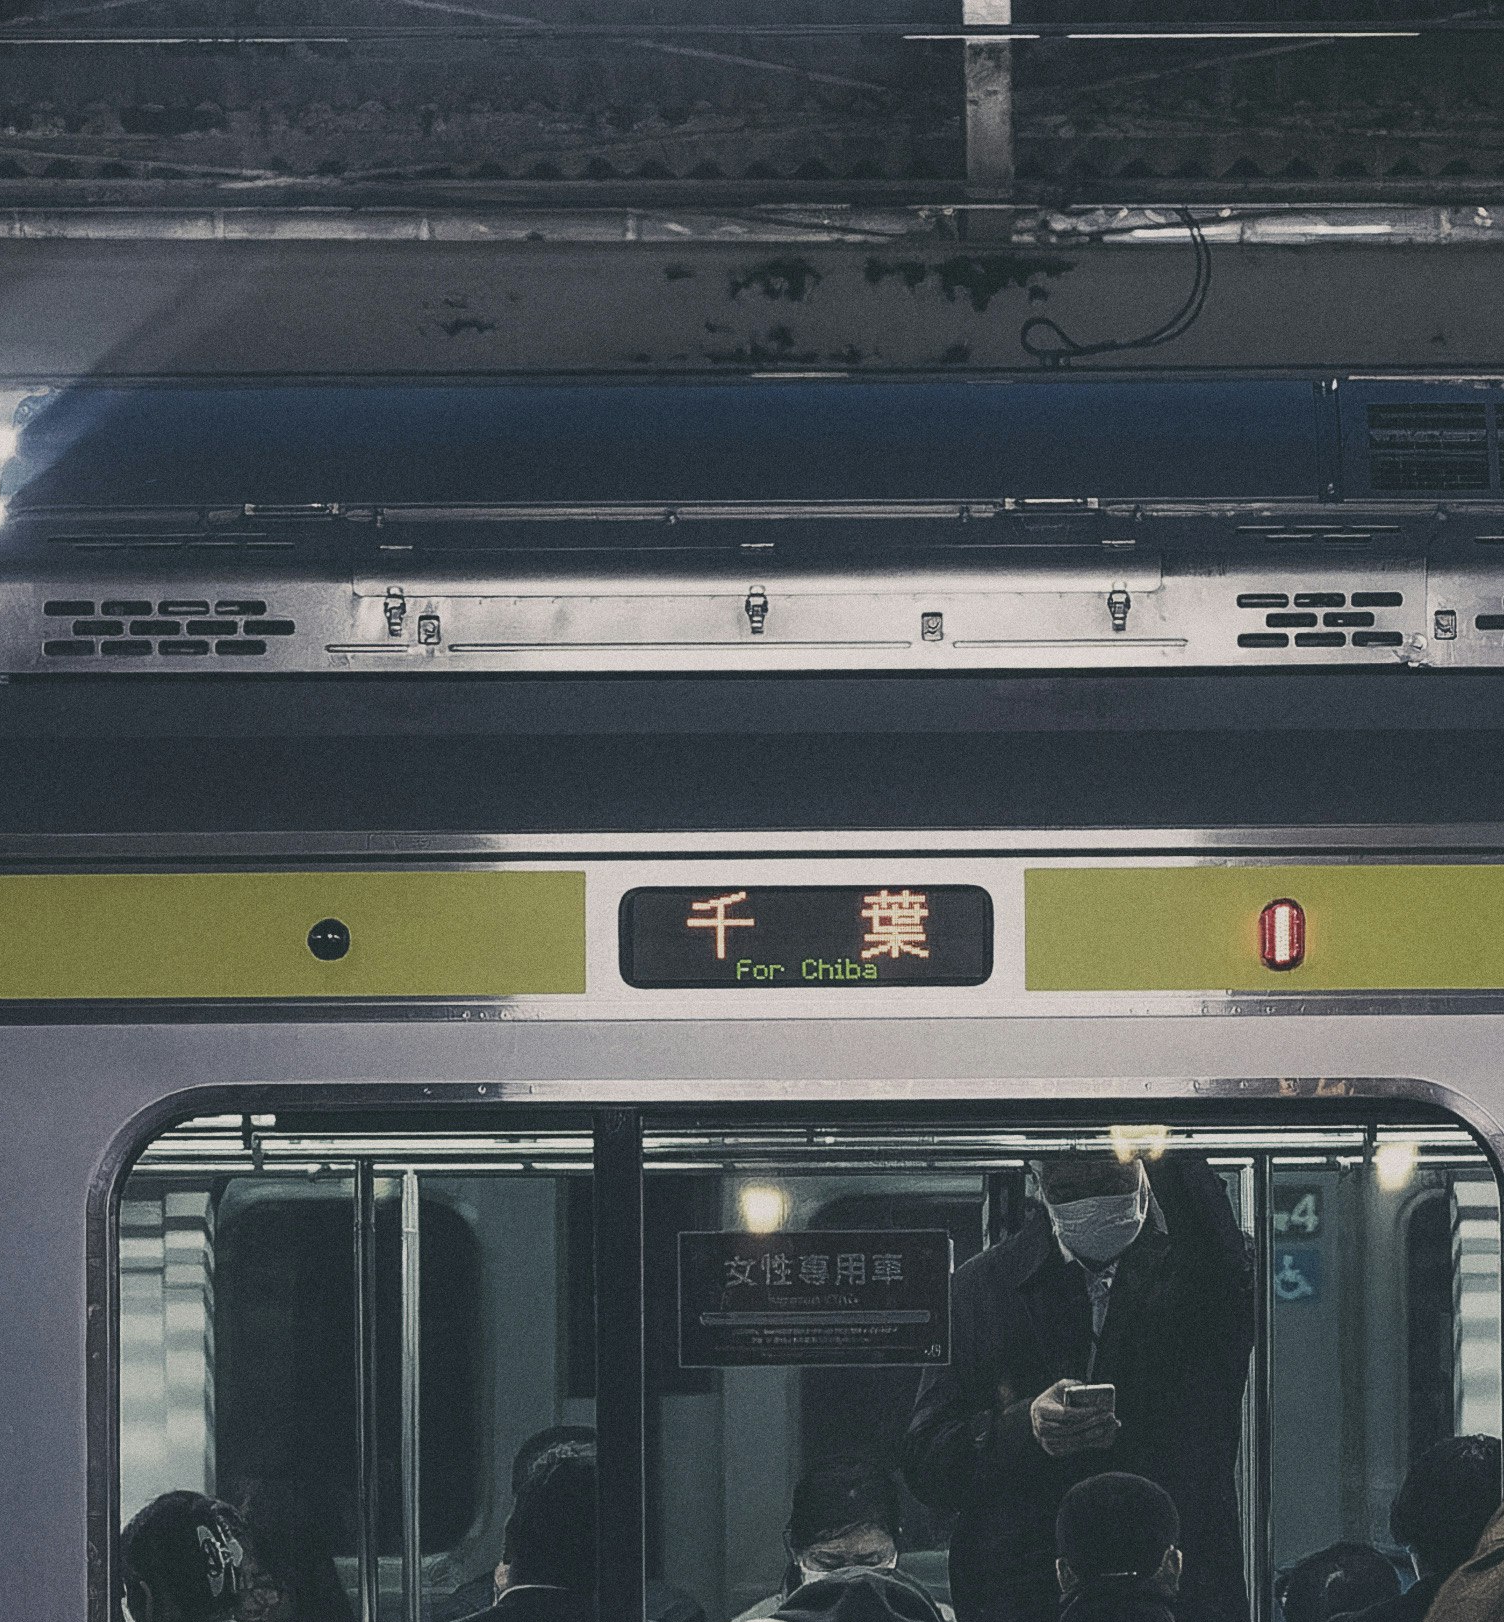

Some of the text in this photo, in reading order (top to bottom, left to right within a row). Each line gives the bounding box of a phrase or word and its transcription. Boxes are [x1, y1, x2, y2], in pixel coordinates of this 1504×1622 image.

[686, 889, 931, 960] 千葉
[735, 958, 879, 981] For Chiba
[723, 1253, 905, 1287] 女性専用車
